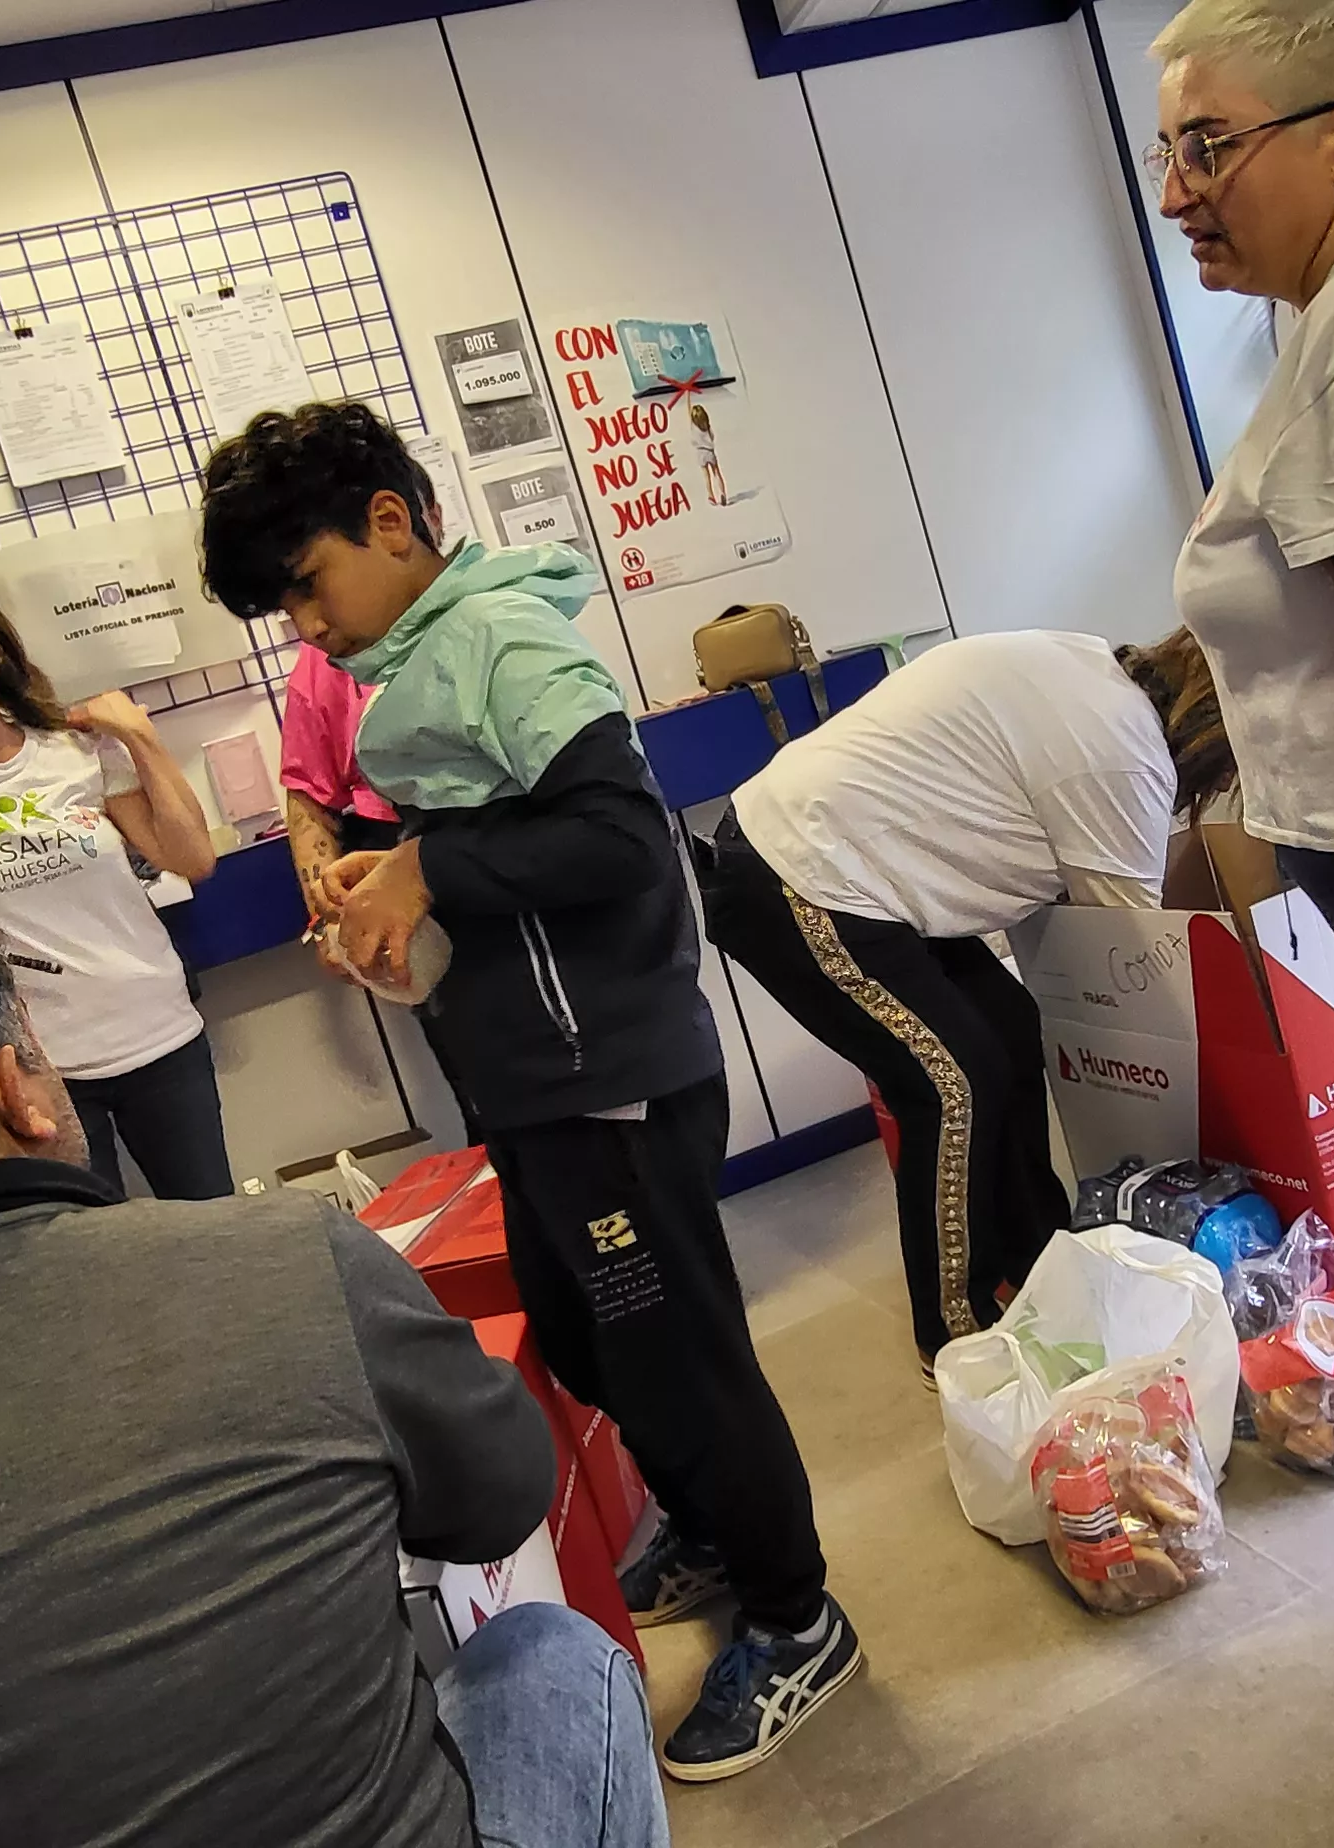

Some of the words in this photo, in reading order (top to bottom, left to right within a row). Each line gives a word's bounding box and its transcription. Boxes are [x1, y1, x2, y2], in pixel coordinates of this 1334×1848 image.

[463, 331, 498, 354] BOTE
[555, 323, 618, 362] CON
[464, 370, 521, 391] 1.095.000
[565, 370, 604, 411] EL
[584, 402, 668, 454] JUEGO
[593, 454, 638, 496] NO
[646, 440, 678, 479] SE
[510, 477, 545, 501] BOTE
[523, 517, 556, 534] 8.500
[610, 481, 691, 539] JUEGA
[53, 596, 100, 616] Lotería
[125, 578, 177, 599] Nacional
[63, 628, 91, 641] LISTA
[92, 619, 129, 634] OFICIAL
[130, 616, 144, 625] DE
[144, 607, 185, 621] PREMIOS
[0, 852, 71, 883] HUESCA
[1077, 1047, 1169, 1090] Humeco
